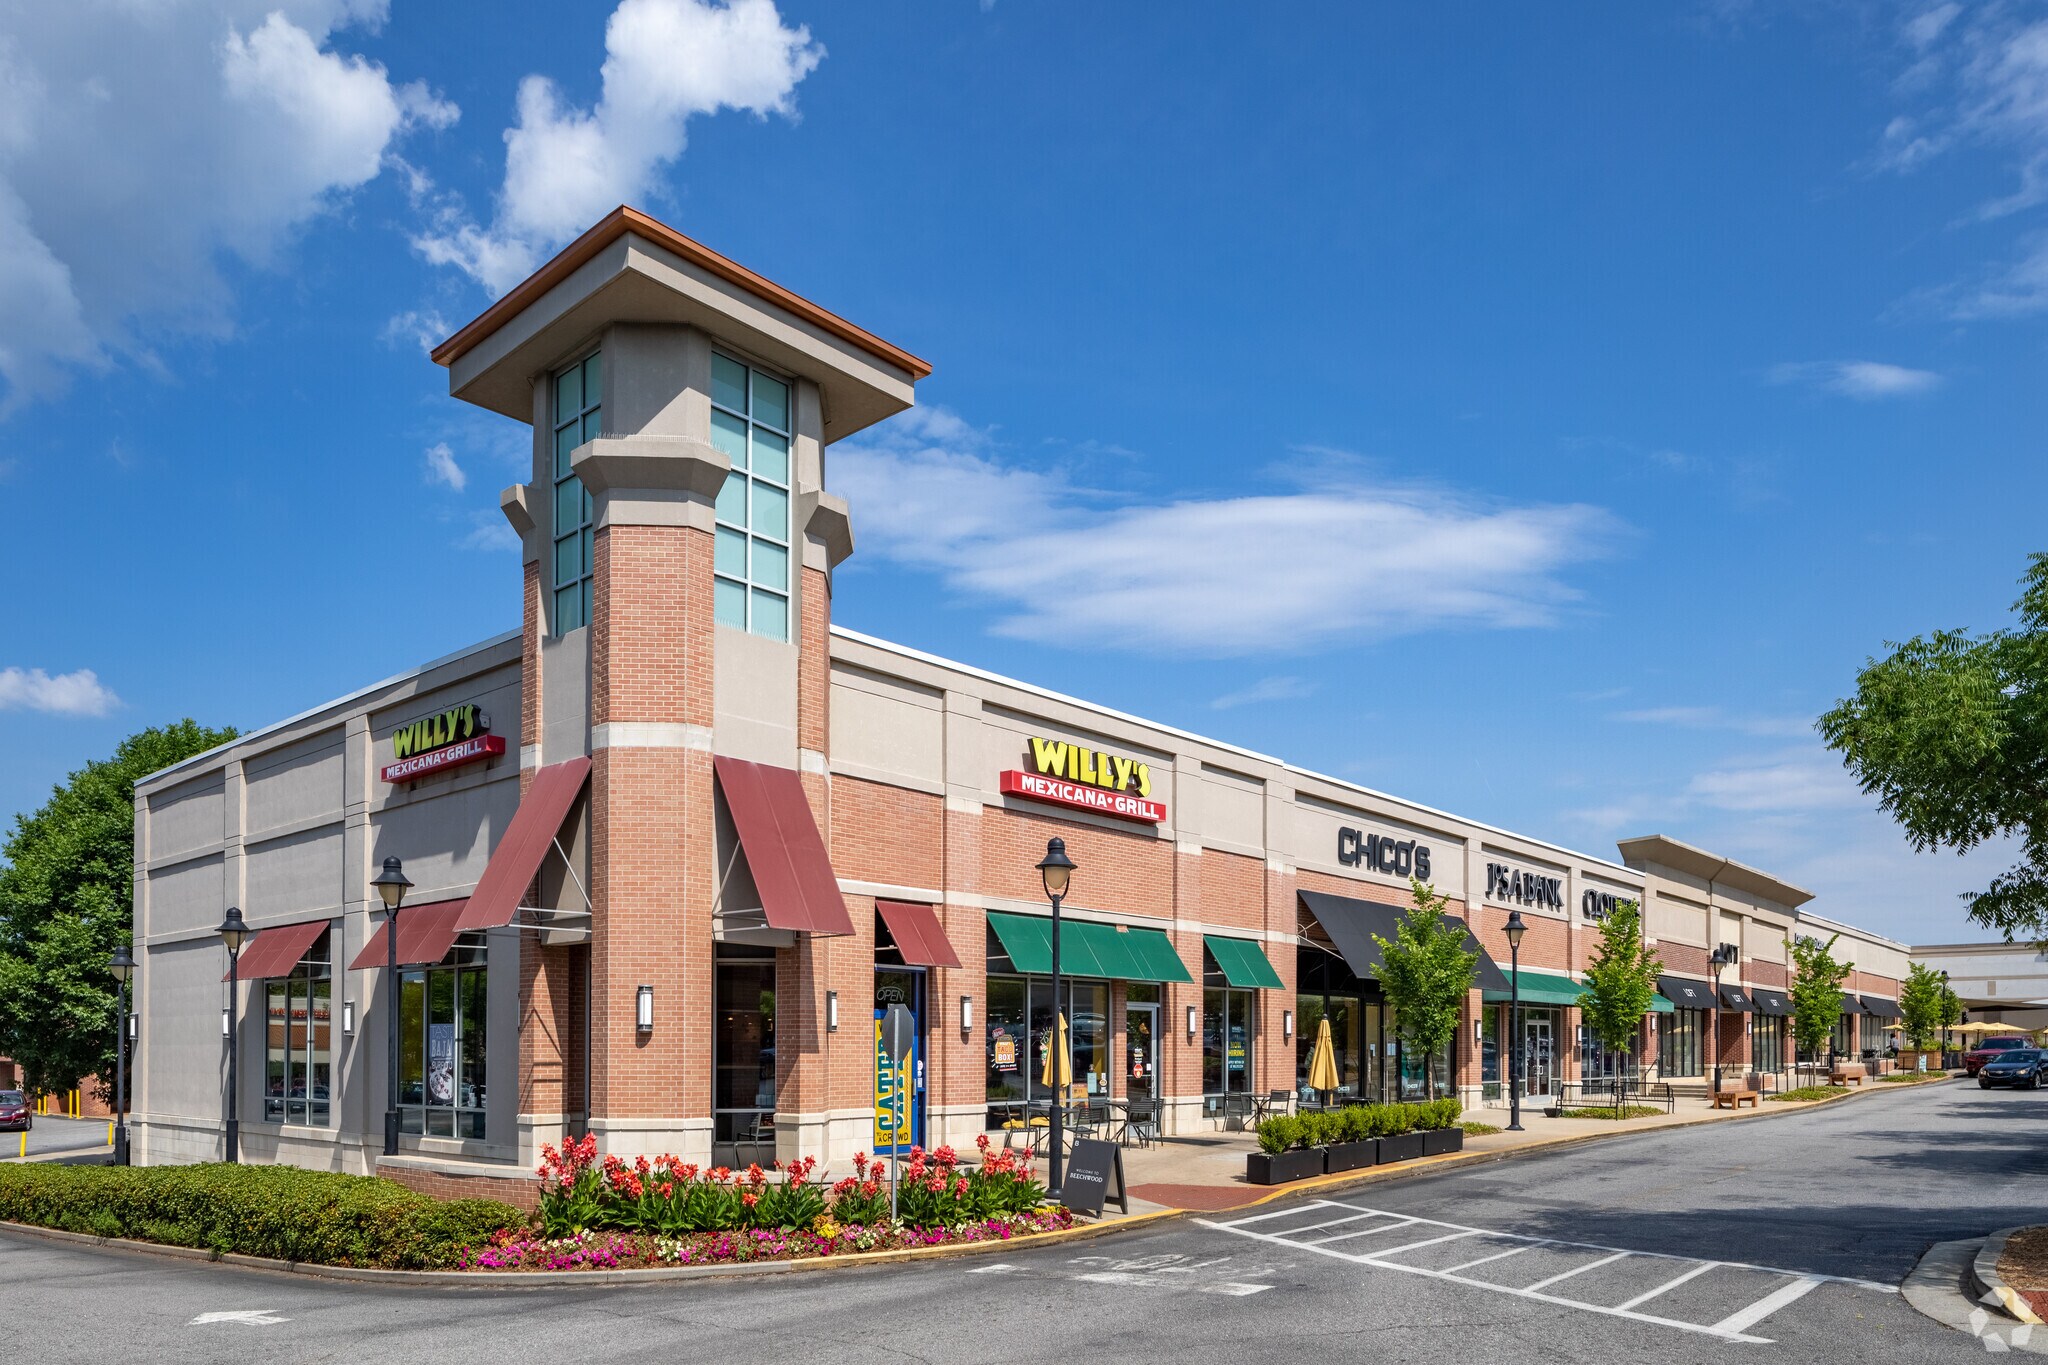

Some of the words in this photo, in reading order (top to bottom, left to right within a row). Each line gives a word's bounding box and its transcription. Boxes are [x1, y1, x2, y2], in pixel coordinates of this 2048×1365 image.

[393, 704, 476, 758] WILLY'S
[386, 753, 441, 778] MEXICANA
[447, 741, 481, 760] GRILL
[1028, 737, 1151, 797] WILLY'S
[1021, 775, 1107, 808] MEXICANA
[1115, 797, 1159, 819] GRILL
[1338, 826, 1430, 879] CHICO'S
[1523, 872, 1564, 907] BANK
[877, 989, 904, 1001] OPEN
[431, 1040, 452, 1057] BAJA
[882, 1132, 909, 1142] CRWD
[1070, 1173, 1103, 1183] BEECHWOOD
